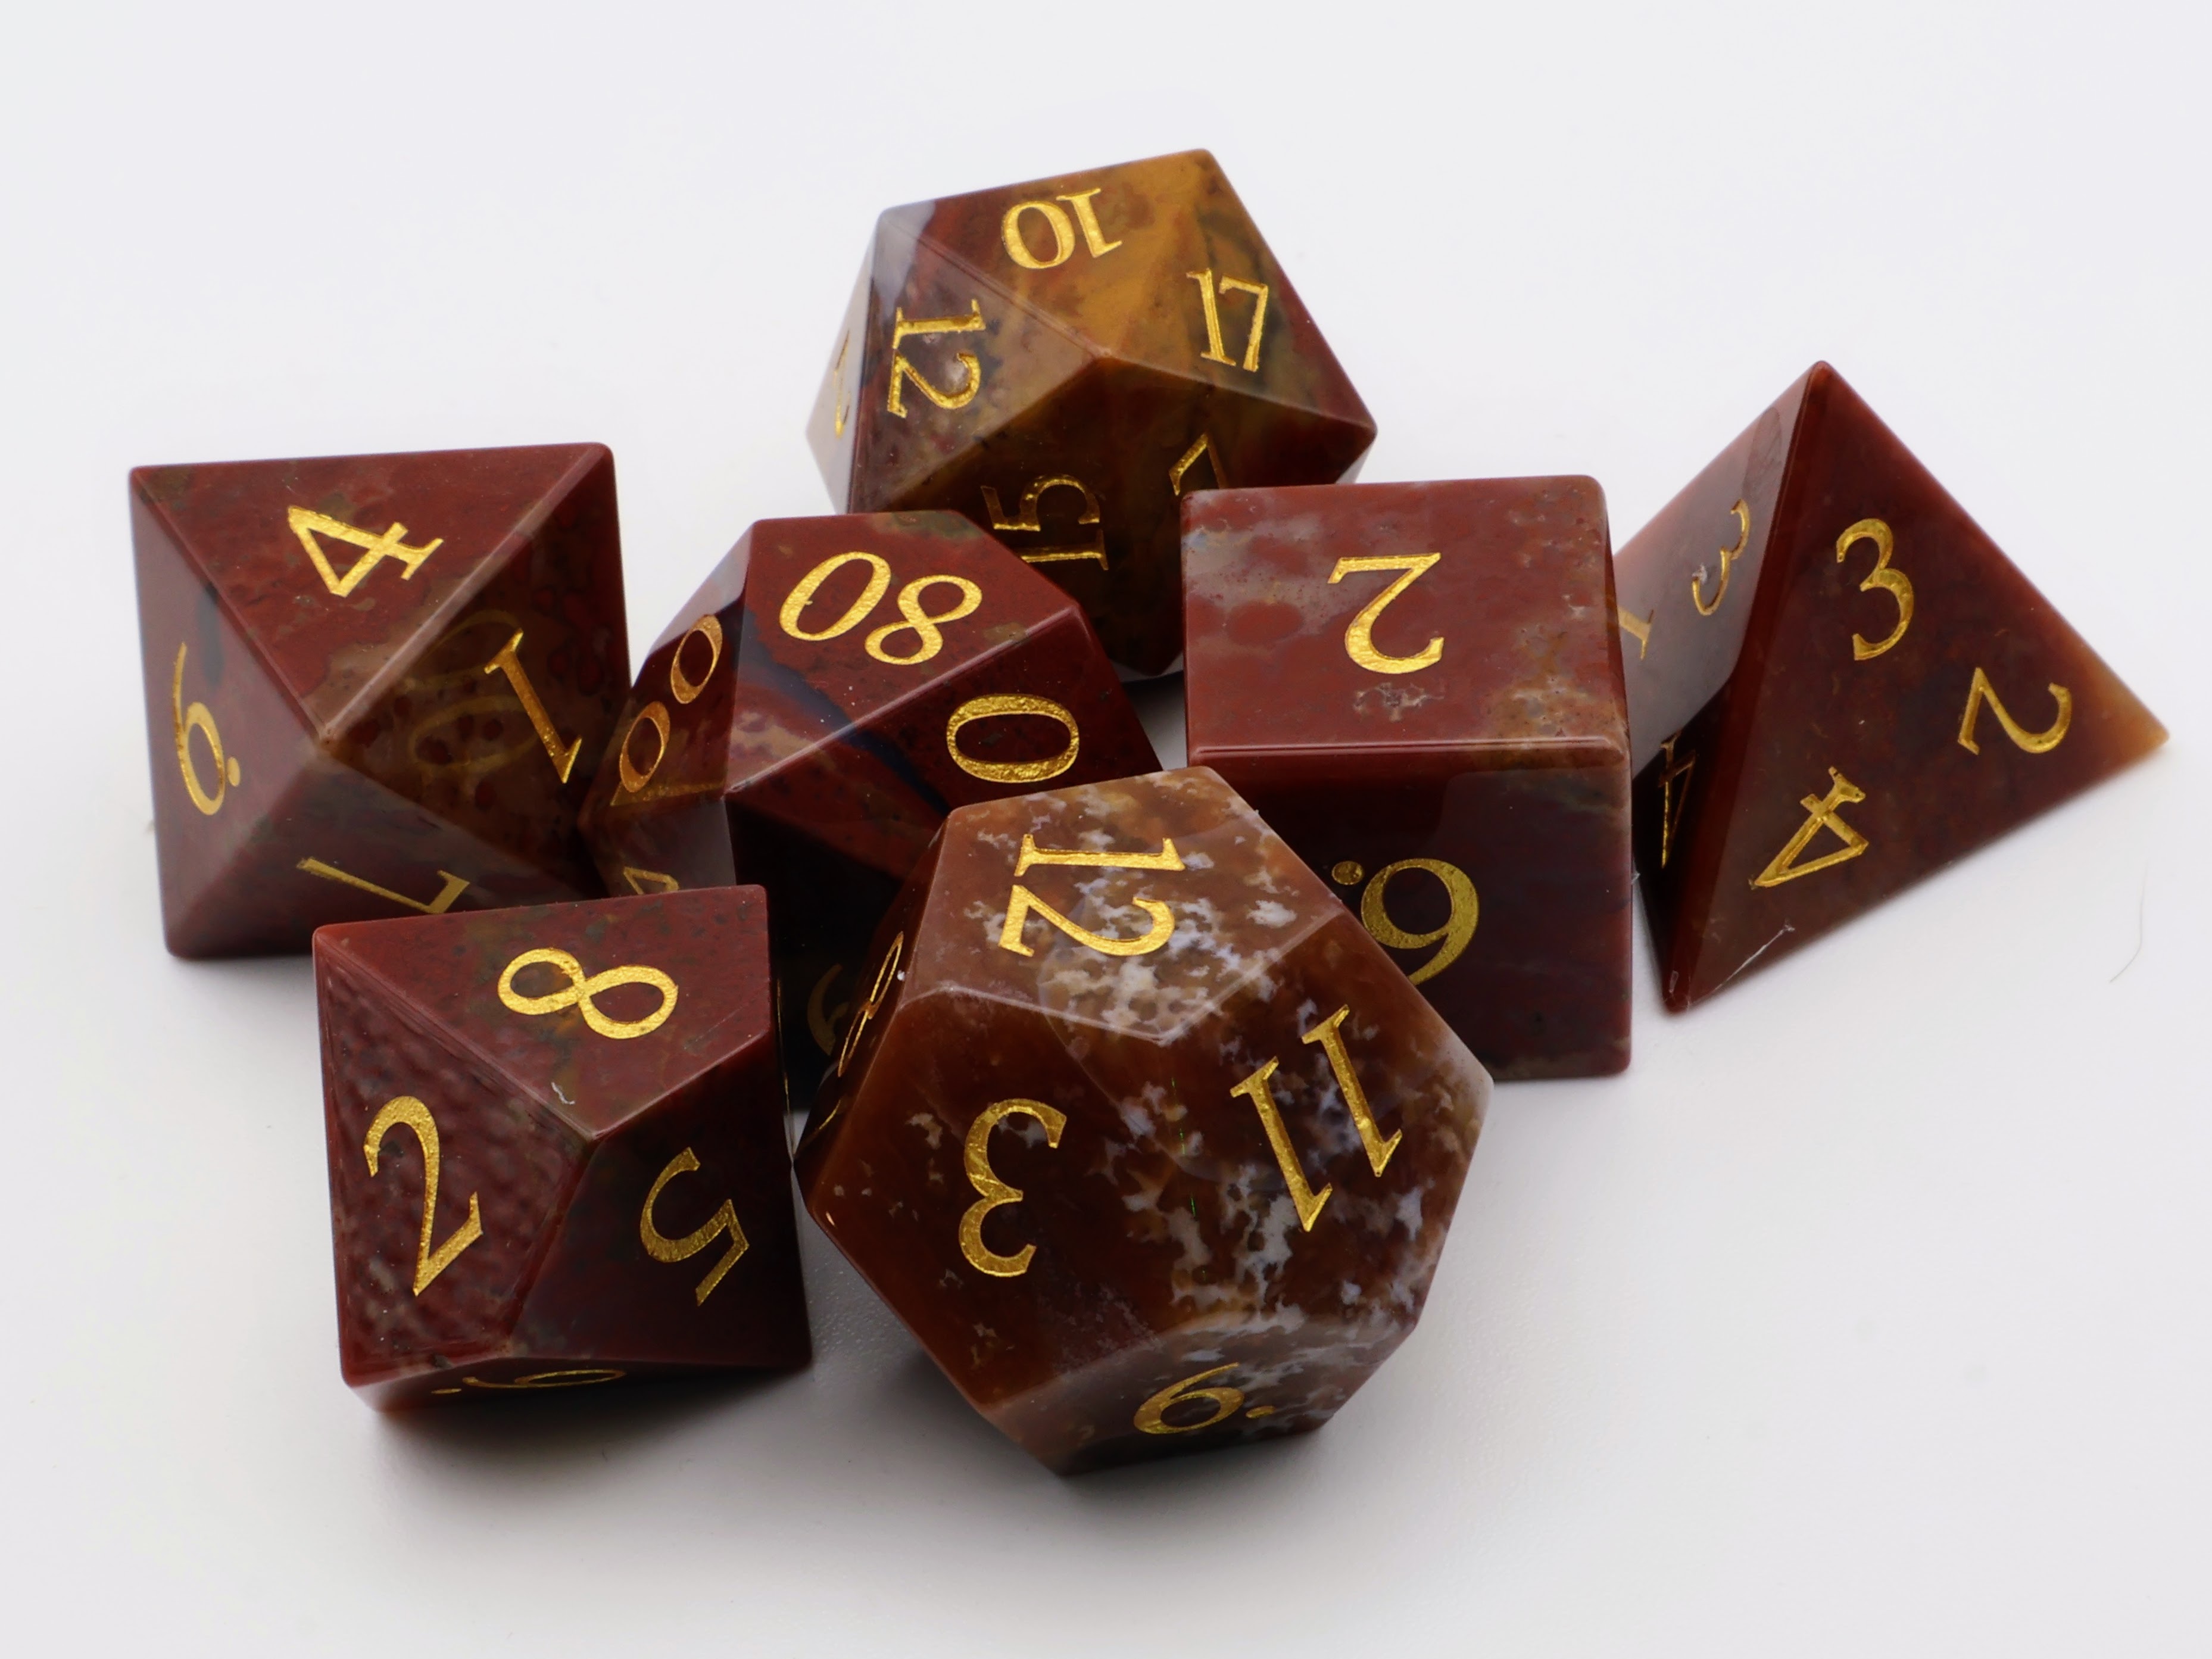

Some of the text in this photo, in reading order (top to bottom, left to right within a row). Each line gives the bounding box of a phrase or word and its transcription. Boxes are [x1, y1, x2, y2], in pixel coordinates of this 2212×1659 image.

[1002, 188, 1123, 270] 10
[887, 298, 986, 419] 12
[1186, 267, 1269, 373] 17
[288, 506, 444, 598] 4
[980, 475, 1109, 571] 15
[779, 551, 983, 665] 80
[1327, 552, 1444, 673] 2
[1836, 517, 1914, 661] 3
[484, 628, 583, 784] 1
[1957, 667, 2073, 755] 2
[1749, 766, 1869, 889] 4
[998, 834, 1186, 958] 12
[498, 947, 679, 1040] 8
[1230, 1004, 1403, 1233] 11
[363, 1096, 484, 1297] 2
[639, 1147, 750, 1307] 5
[958, 1098, 1068, 1278] 3
